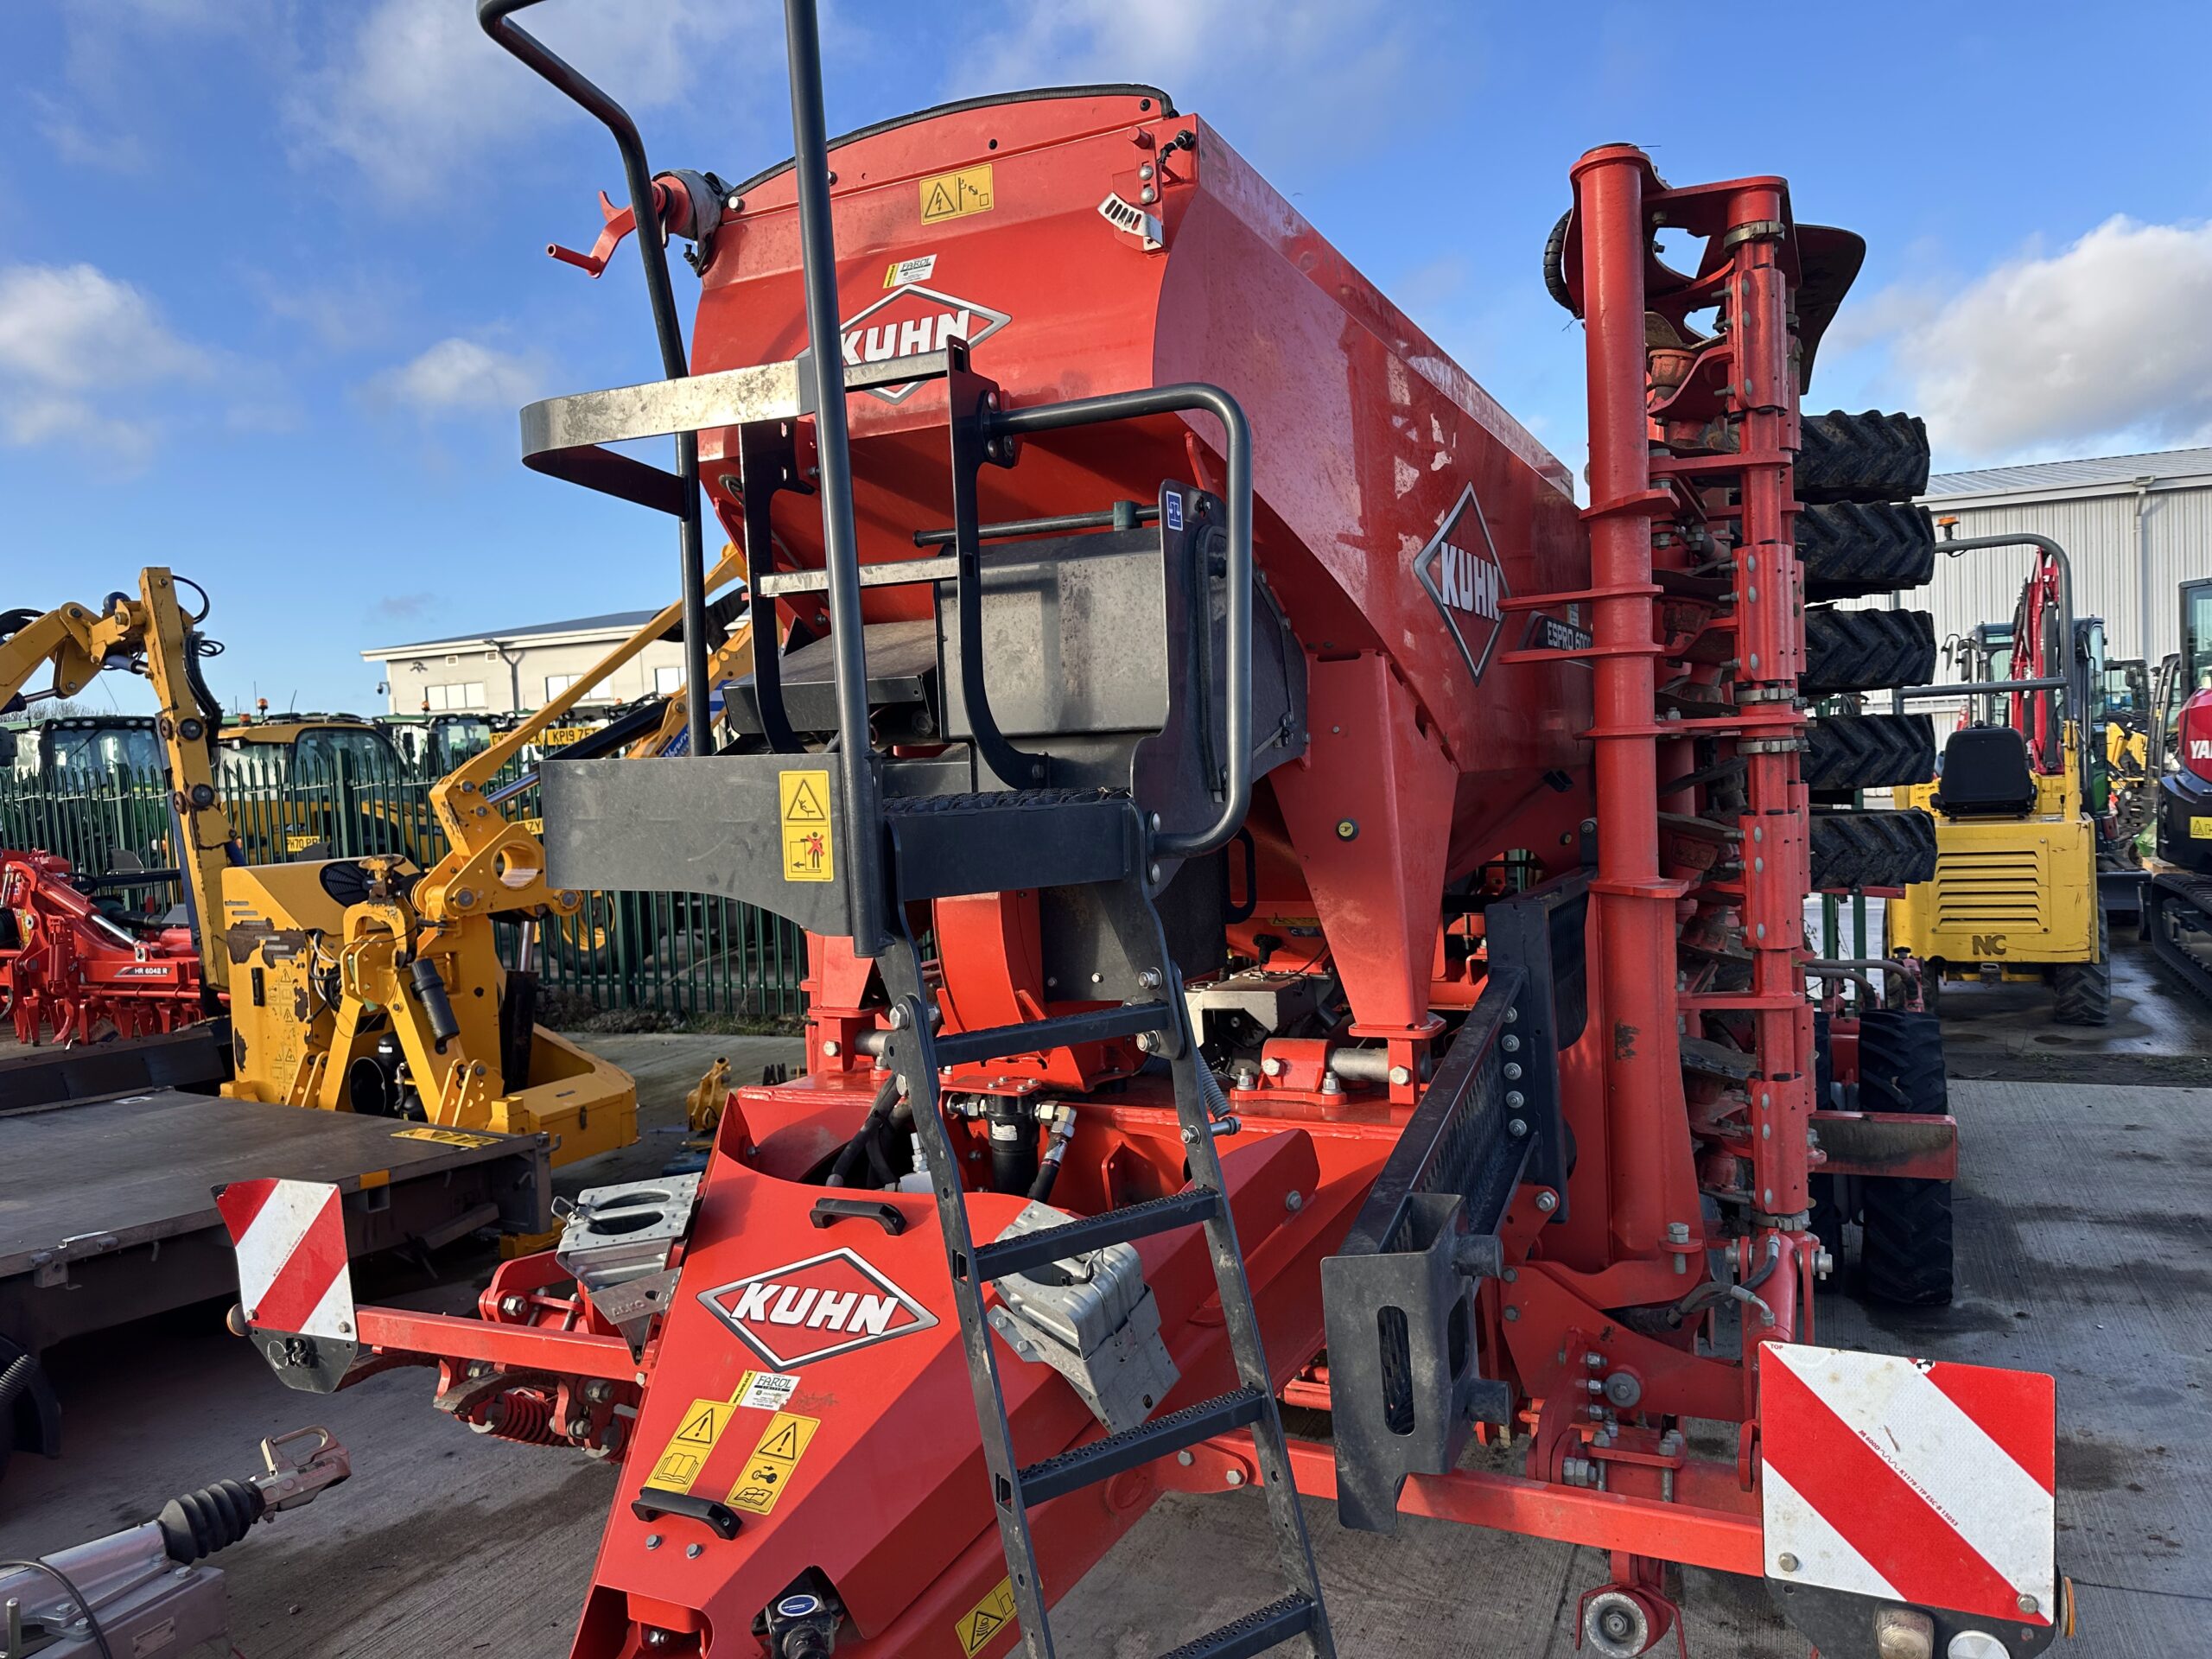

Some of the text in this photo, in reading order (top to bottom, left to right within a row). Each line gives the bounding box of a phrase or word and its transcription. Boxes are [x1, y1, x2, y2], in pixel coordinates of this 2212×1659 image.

[841, 309, 969, 365] KUHN
[1440, 541, 1500, 623] KUHN
[1548, 620, 1573, 650] ESPRO
[552, 729, 575, 743] KP19
[2190, 740, 2212, 760] YA
[1972, 934, 2006, 956] NC
[730, 1283, 899, 1335] KUHN
[757, 1375, 792, 1389] FAROL
